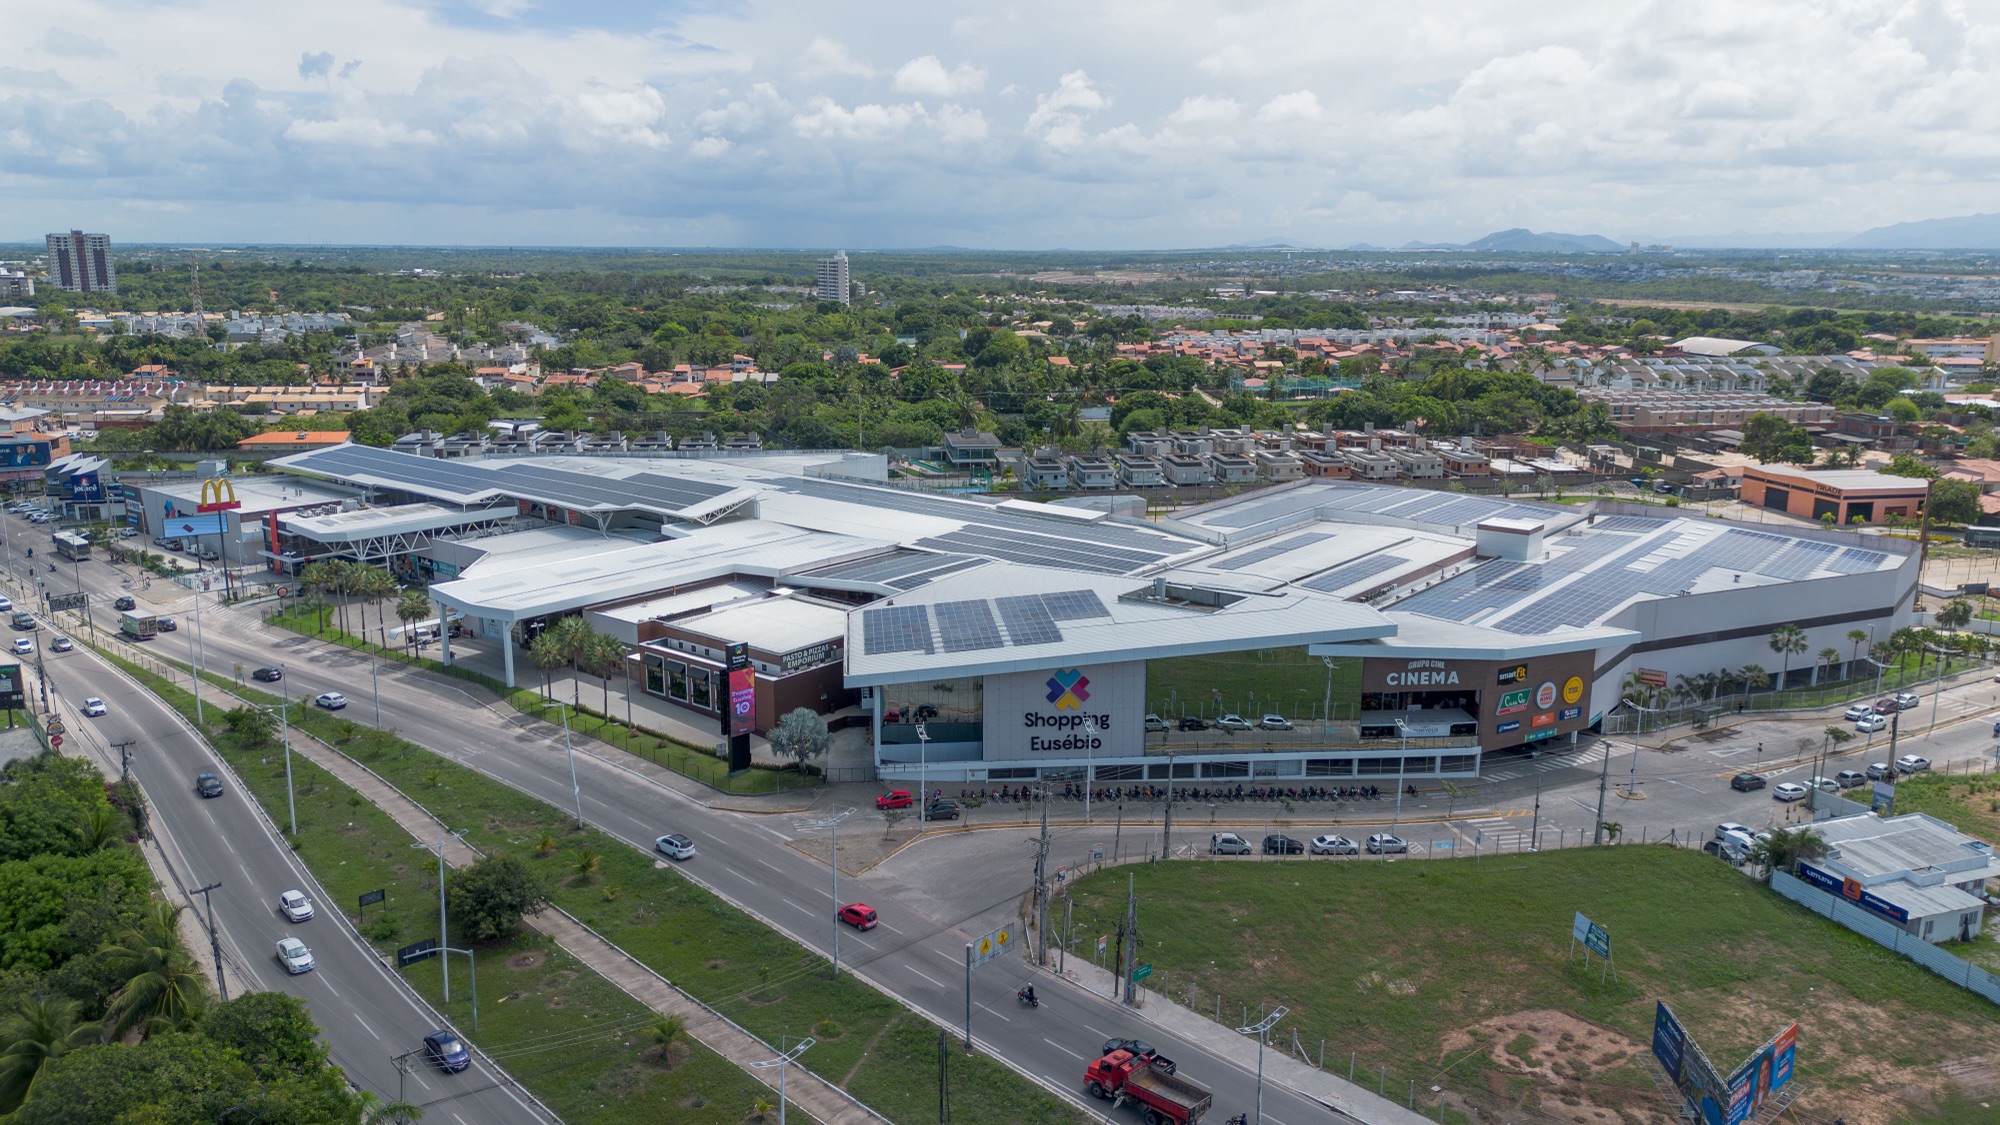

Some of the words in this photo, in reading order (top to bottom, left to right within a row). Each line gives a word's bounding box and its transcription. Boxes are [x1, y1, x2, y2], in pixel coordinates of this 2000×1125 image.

[783, 652, 802, 663] PASTO
[809, 644, 829, 655] PIZZAS
[788, 652, 825, 669] EMPORIUM
[1408, 660, 1430, 669] GRUPO
[1431, 660, 1445, 669] CINE
[1386, 671, 1459, 686] CINEMA
[1499, 671, 1517, 680] smart
[1031, 734, 1102, 751] Eusébio
